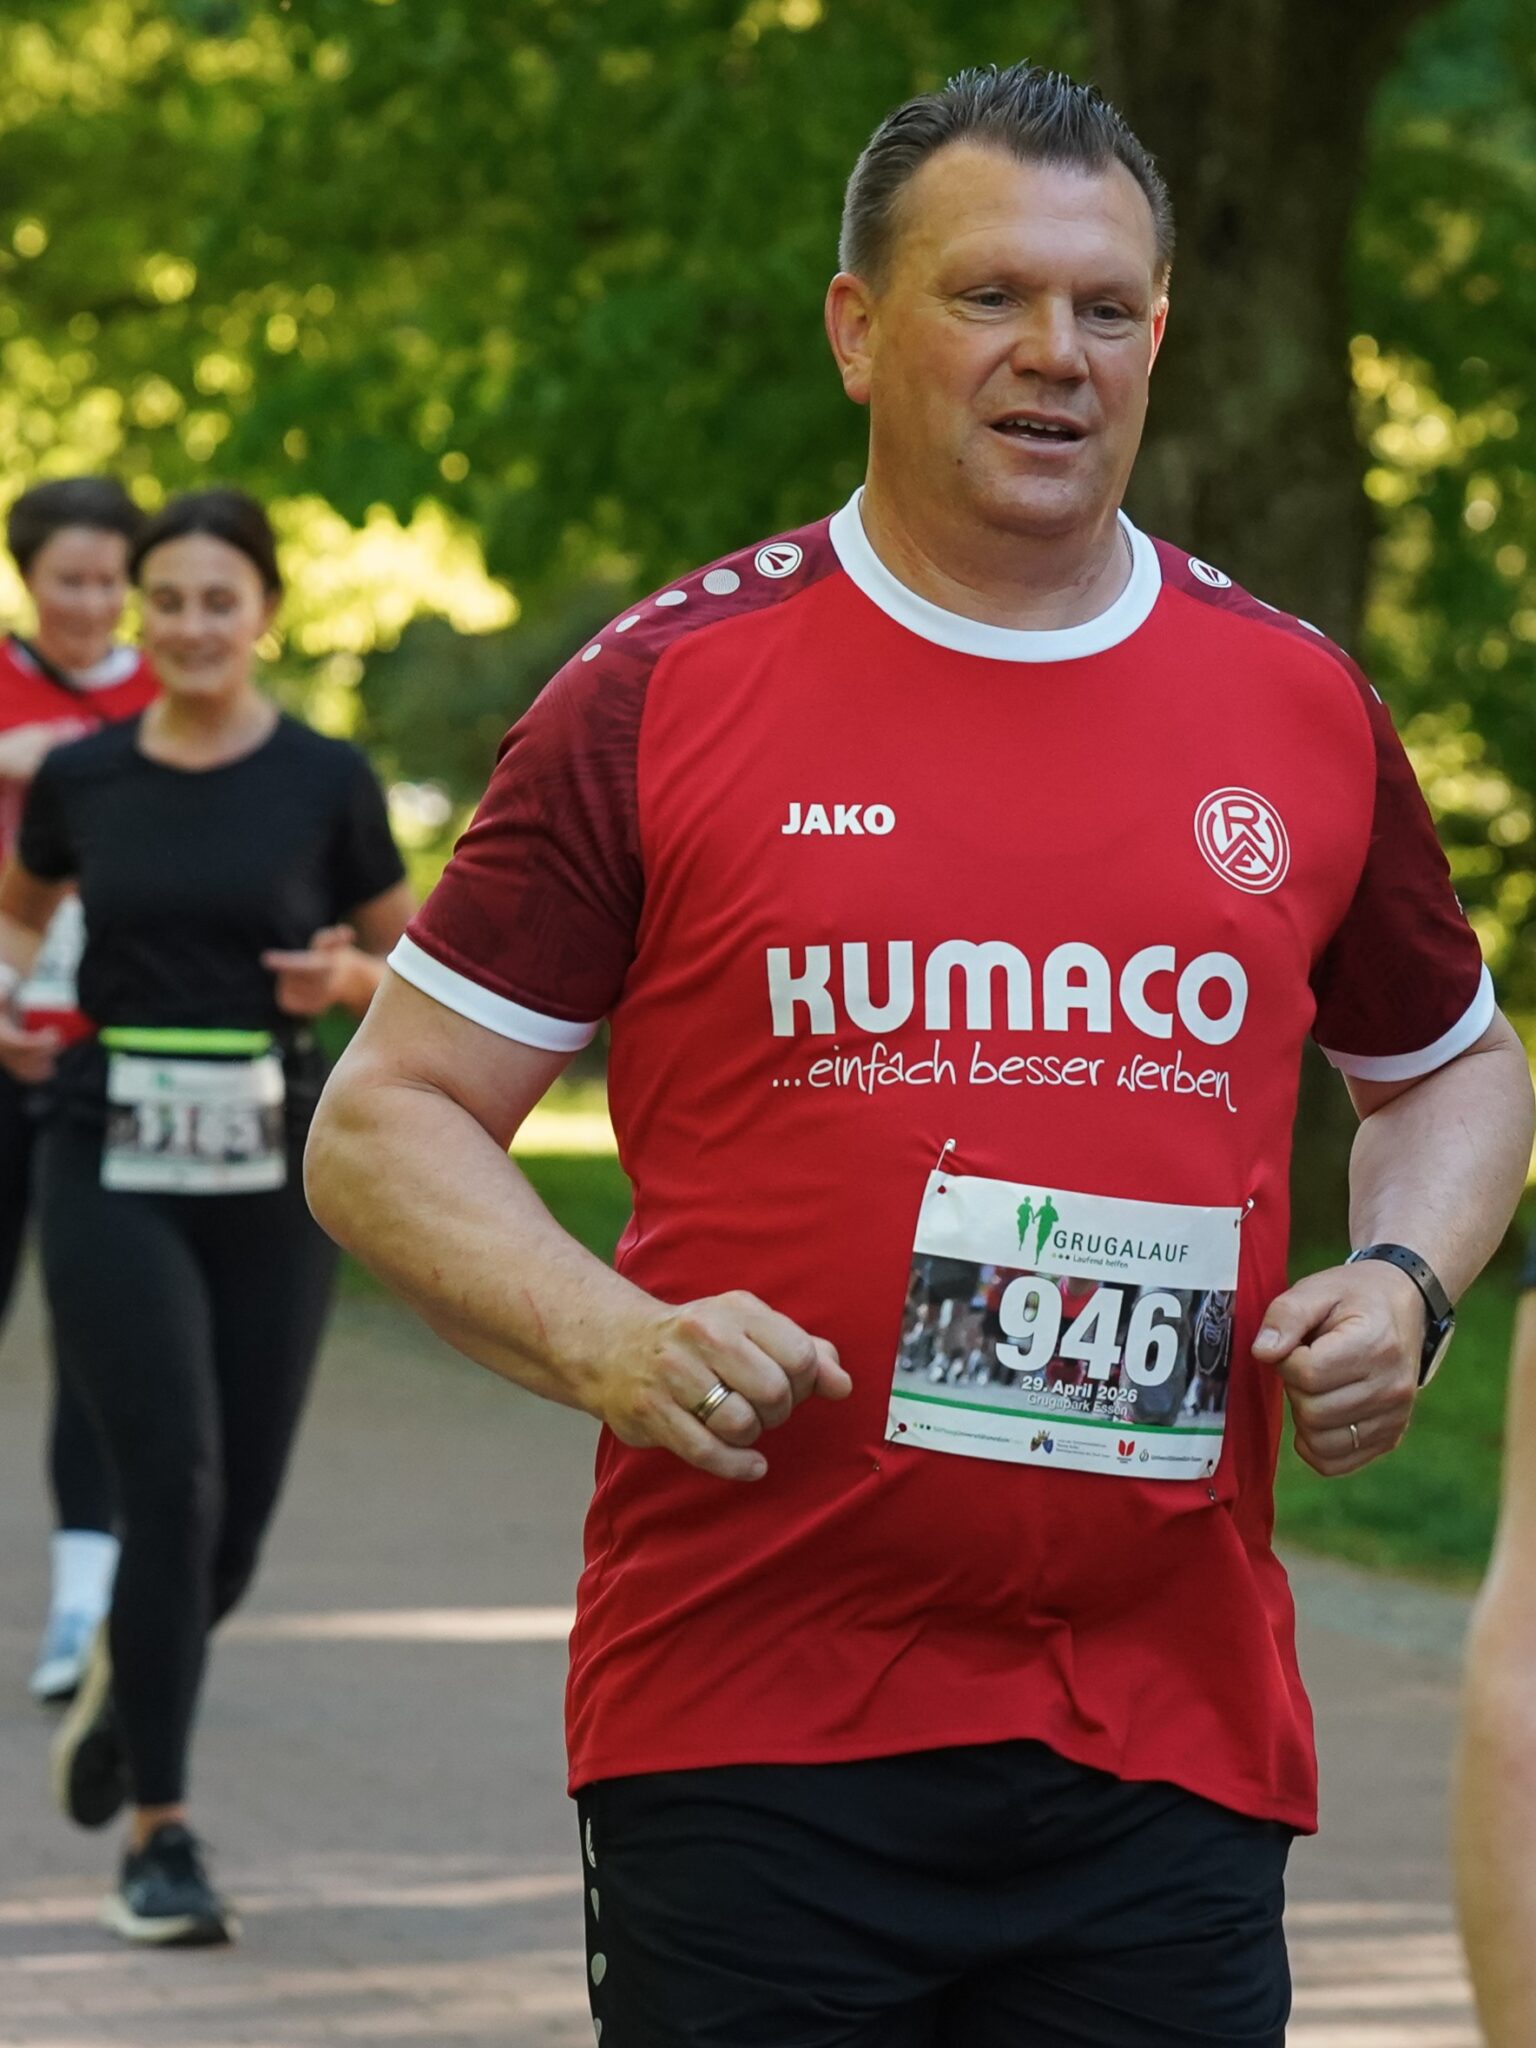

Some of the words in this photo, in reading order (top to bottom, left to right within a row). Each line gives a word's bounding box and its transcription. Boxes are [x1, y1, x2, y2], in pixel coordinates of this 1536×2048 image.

[782, 802, 896, 836] JAKO
[766, 939, 1249, 1046] KUMACO
[969, 1041, 1105, 1086] besser
[1117, 1050, 1237, 1112] werben
[1053, 1230, 1189, 1263] GRUGALAUF
[996, 1275, 1182, 1387] 946
[1021, 1375, 1048, 1393] 29.
[1051, 1379, 1093, 1399] April
[1096, 1386, 1138, 1404] 2026
[1027, 1392, 1090, 1413] Grugapark
[1092, 1401, 1128, 1417] Essen
